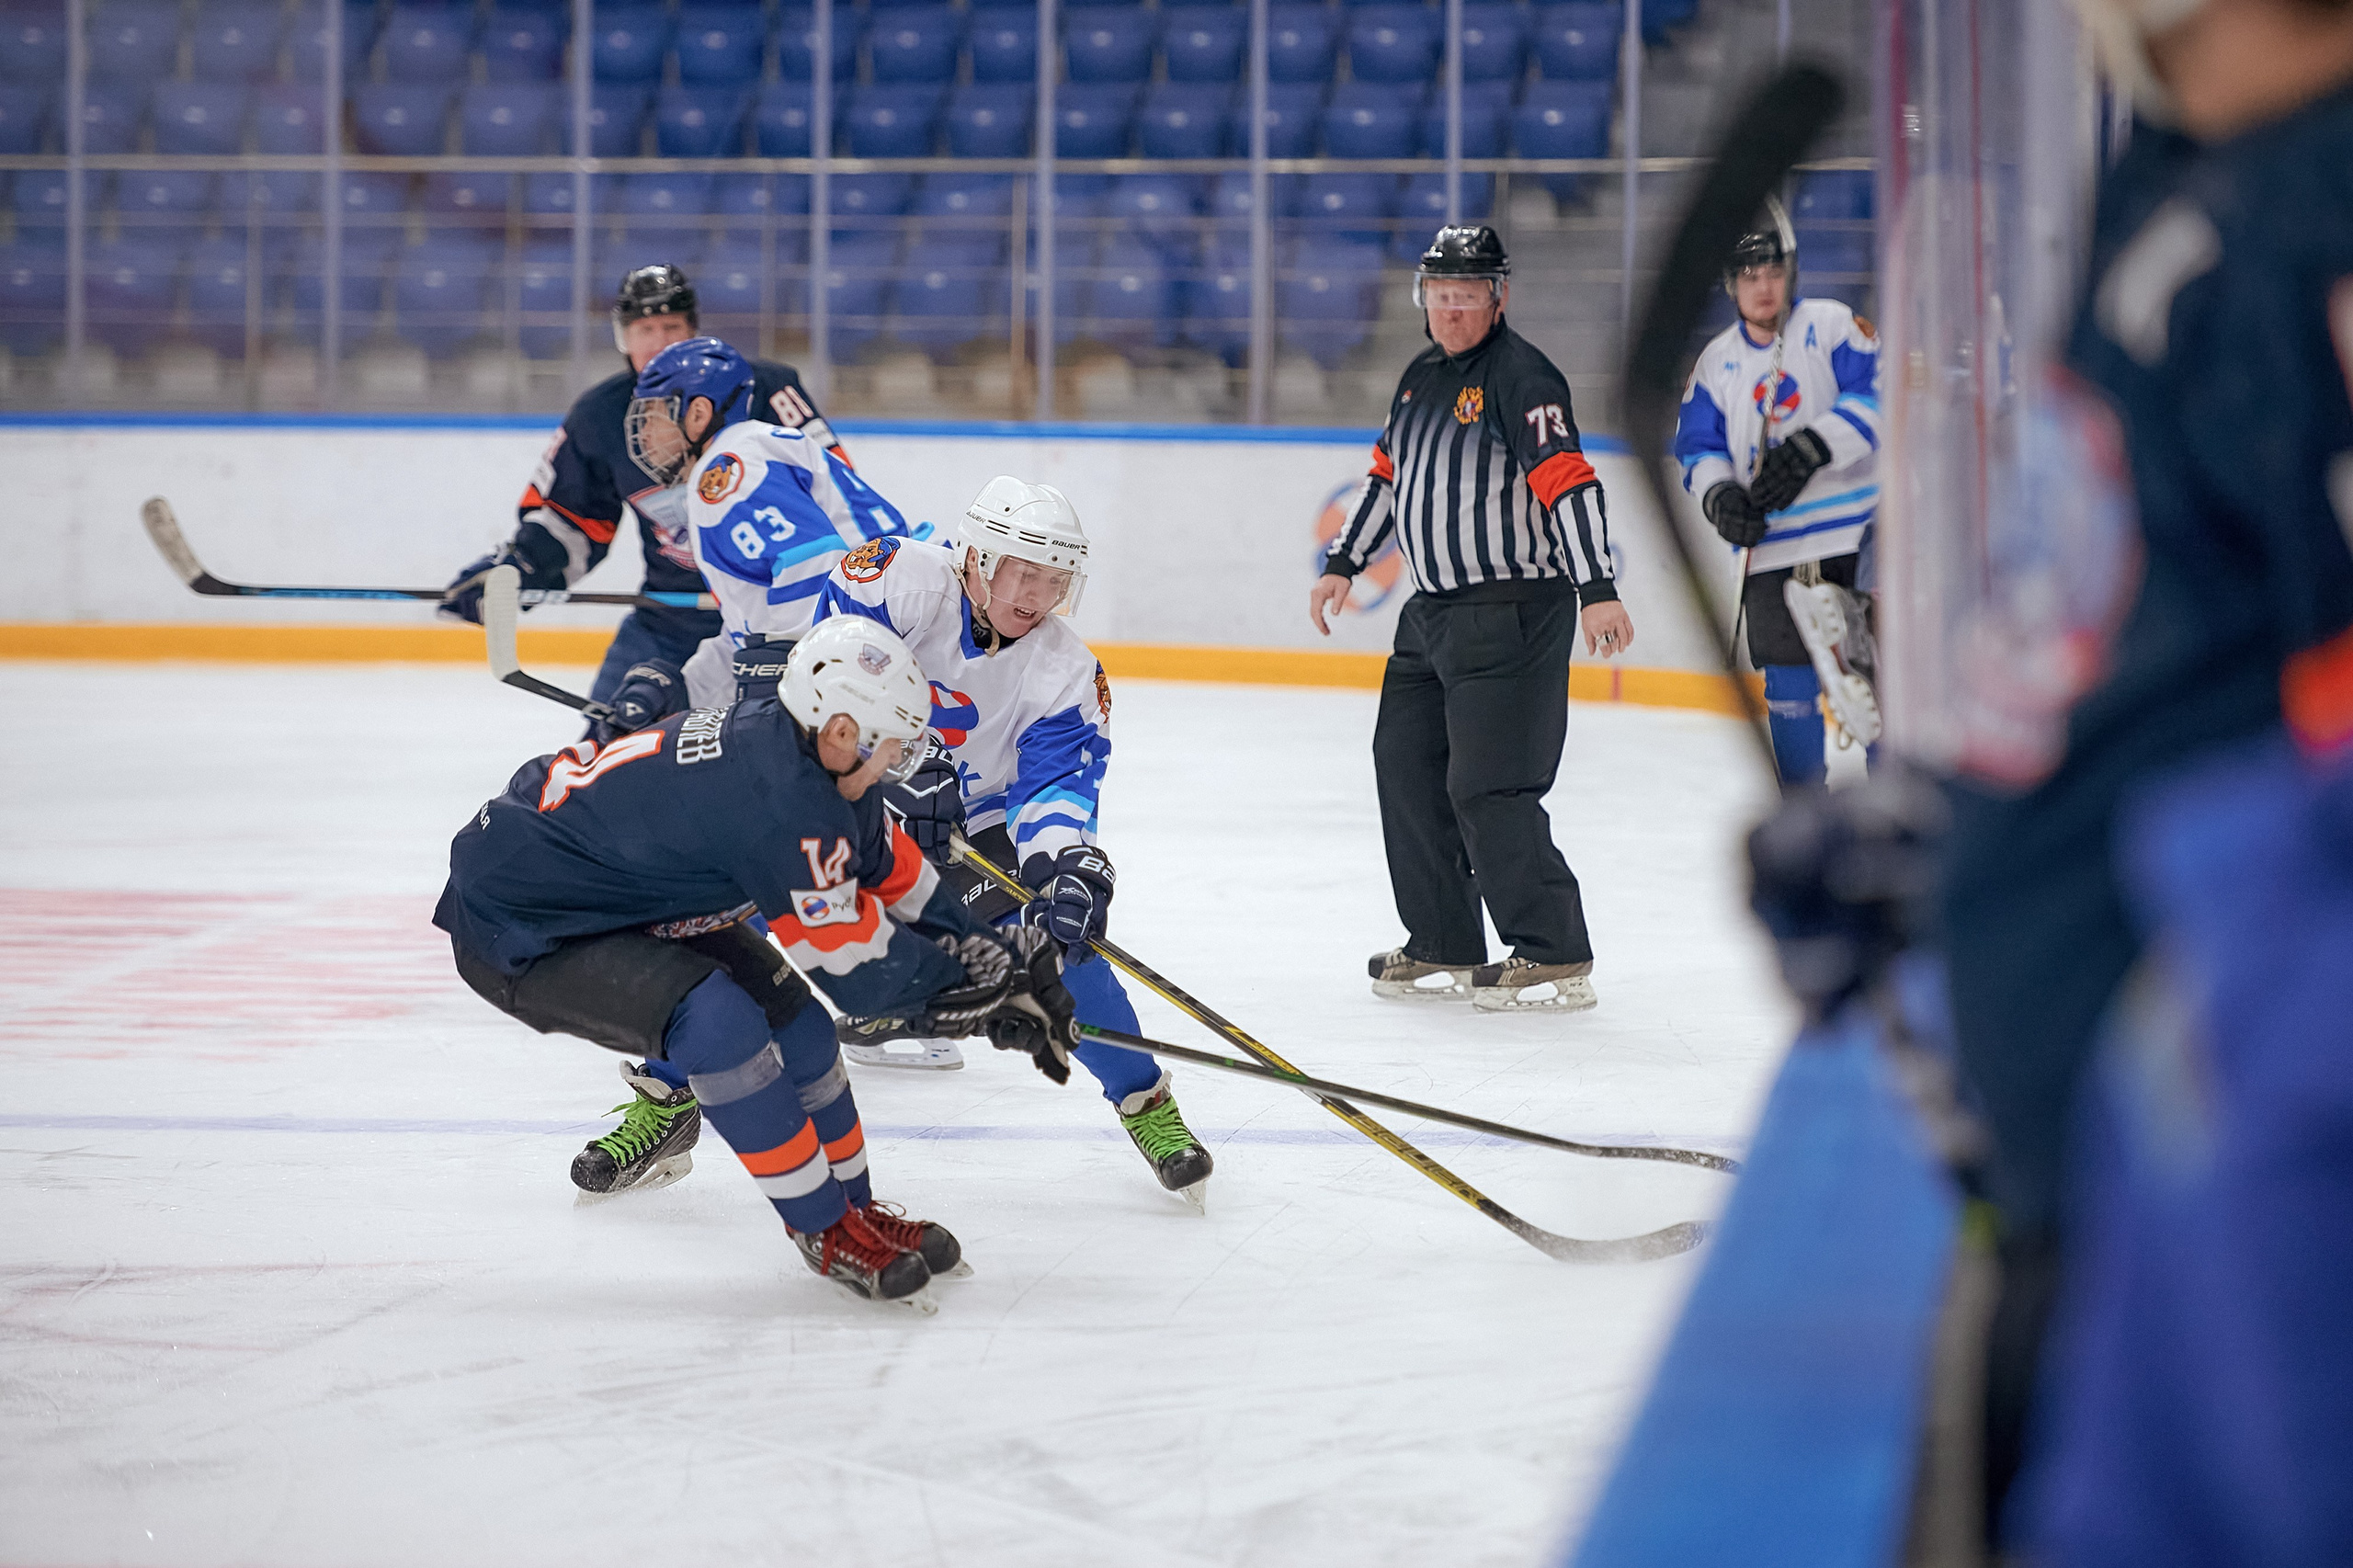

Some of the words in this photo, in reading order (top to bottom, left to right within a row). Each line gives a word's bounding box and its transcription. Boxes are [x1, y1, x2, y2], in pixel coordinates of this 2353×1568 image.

[1804, 322, 1817, 348] A
[1524, 403, 1570, 448] 73
[730, 505, 798, 561] 83
[1051, 540, 1081, 551] BAUER
[800, 835, 852, 890] 14
